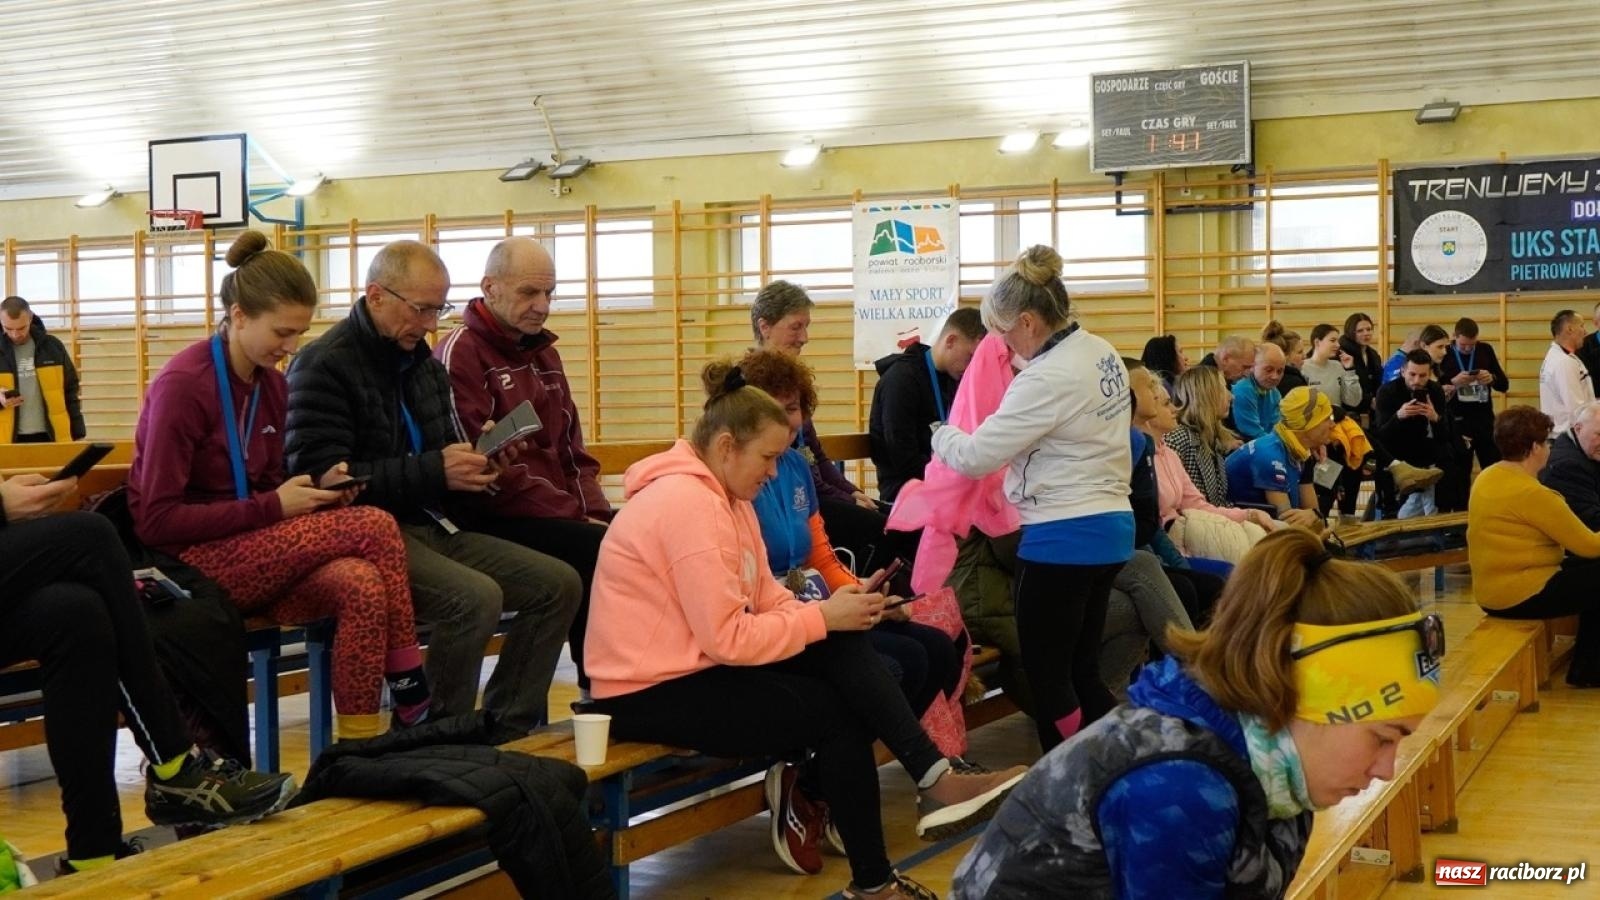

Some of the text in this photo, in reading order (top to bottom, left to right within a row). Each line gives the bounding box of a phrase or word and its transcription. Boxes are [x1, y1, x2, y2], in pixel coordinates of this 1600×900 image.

[1095, 77, 1150, 93] GOSPODARZE
[1173, 80, 1186, 90] GRY
[1200, 69, 1239, 85] GOŚCIE
[1141, 116, 1196, 130] CZAS GRY
[1408, 170, 1590, 202] TRENUJEMY
[1511, 230, 1555, 258] UKS
[868, 257, 898, 267] powiat
[1510, 261, 1594, 281] PIETROWICE
[870, 287, 944, 301] MAŁY SPORT
[859, 307, 905, 320] WIELKA
[1326, 682, 1405, 724] No 2
